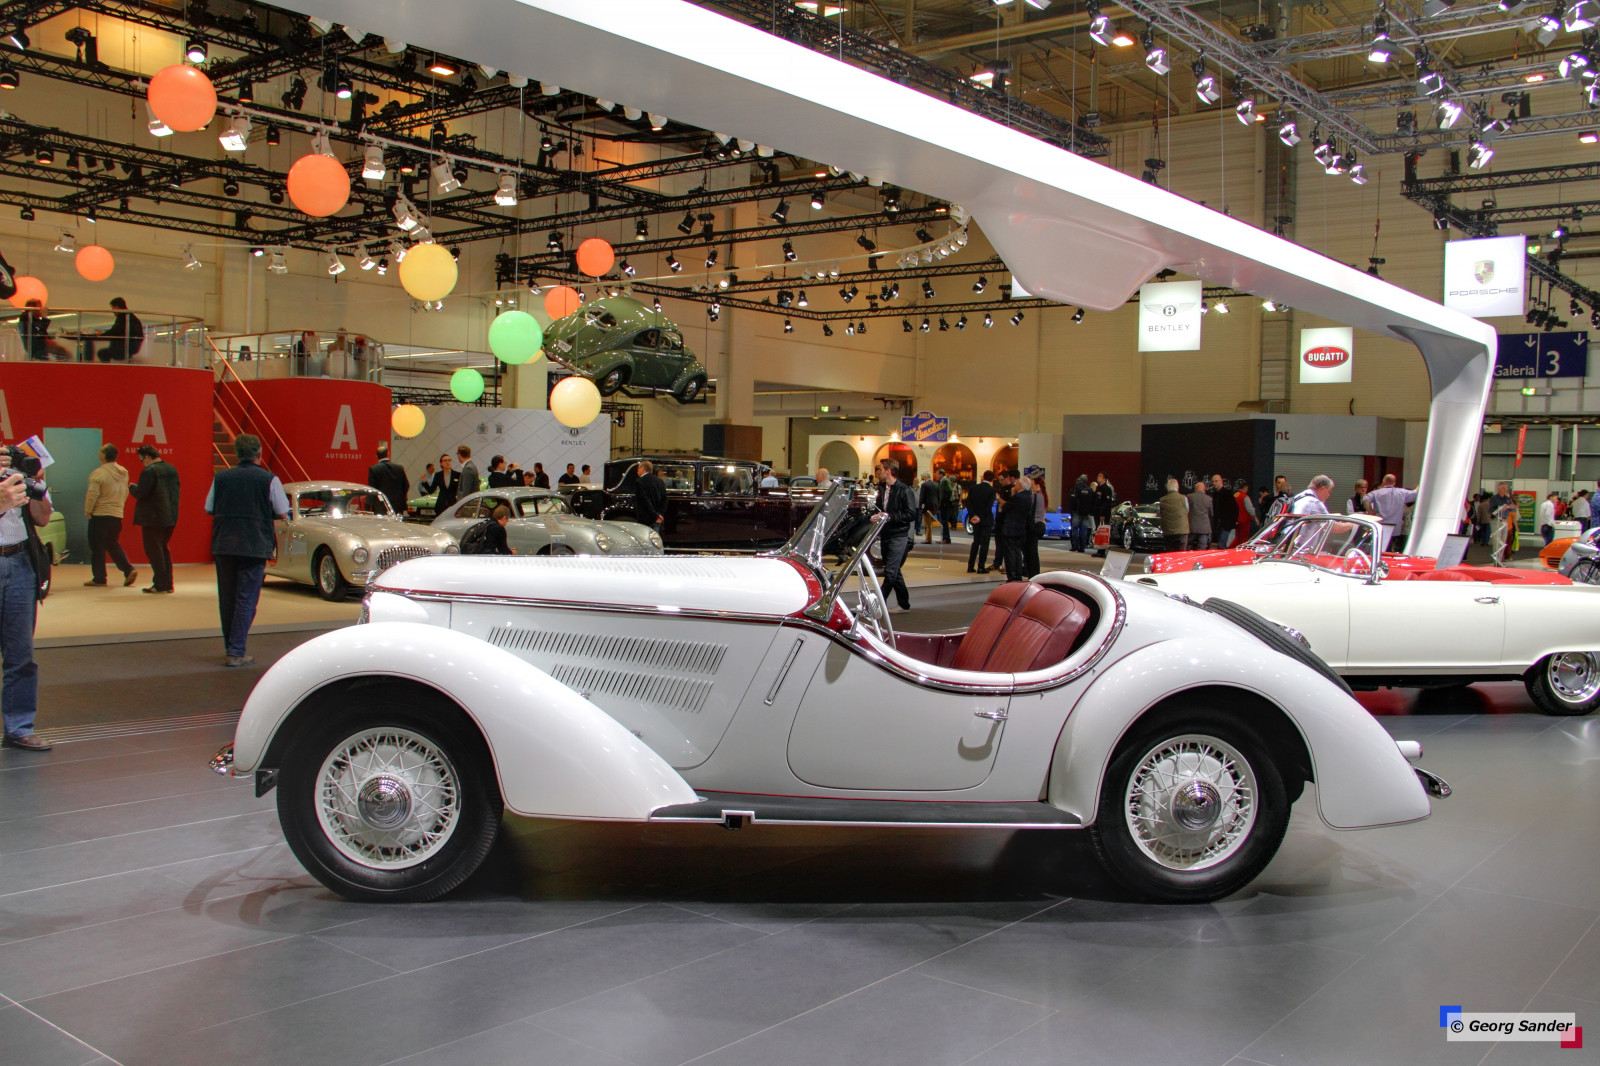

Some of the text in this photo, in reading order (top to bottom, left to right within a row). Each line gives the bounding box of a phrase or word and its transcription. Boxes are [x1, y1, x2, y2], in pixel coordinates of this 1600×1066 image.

[1449, 287, 1518, 296] PORSCHE
[1148, 324, 1190, 332] BENTLEY
[1308, 352, 1344, 362] BUGATTI
[1545, 350, 1560, 375] 3
[1494, 364, 1535, 377] Galeria
[131, 393, 168, 444] A
[330, 404, 358, 450] A
[125, 447, 173, 455] AUADT
